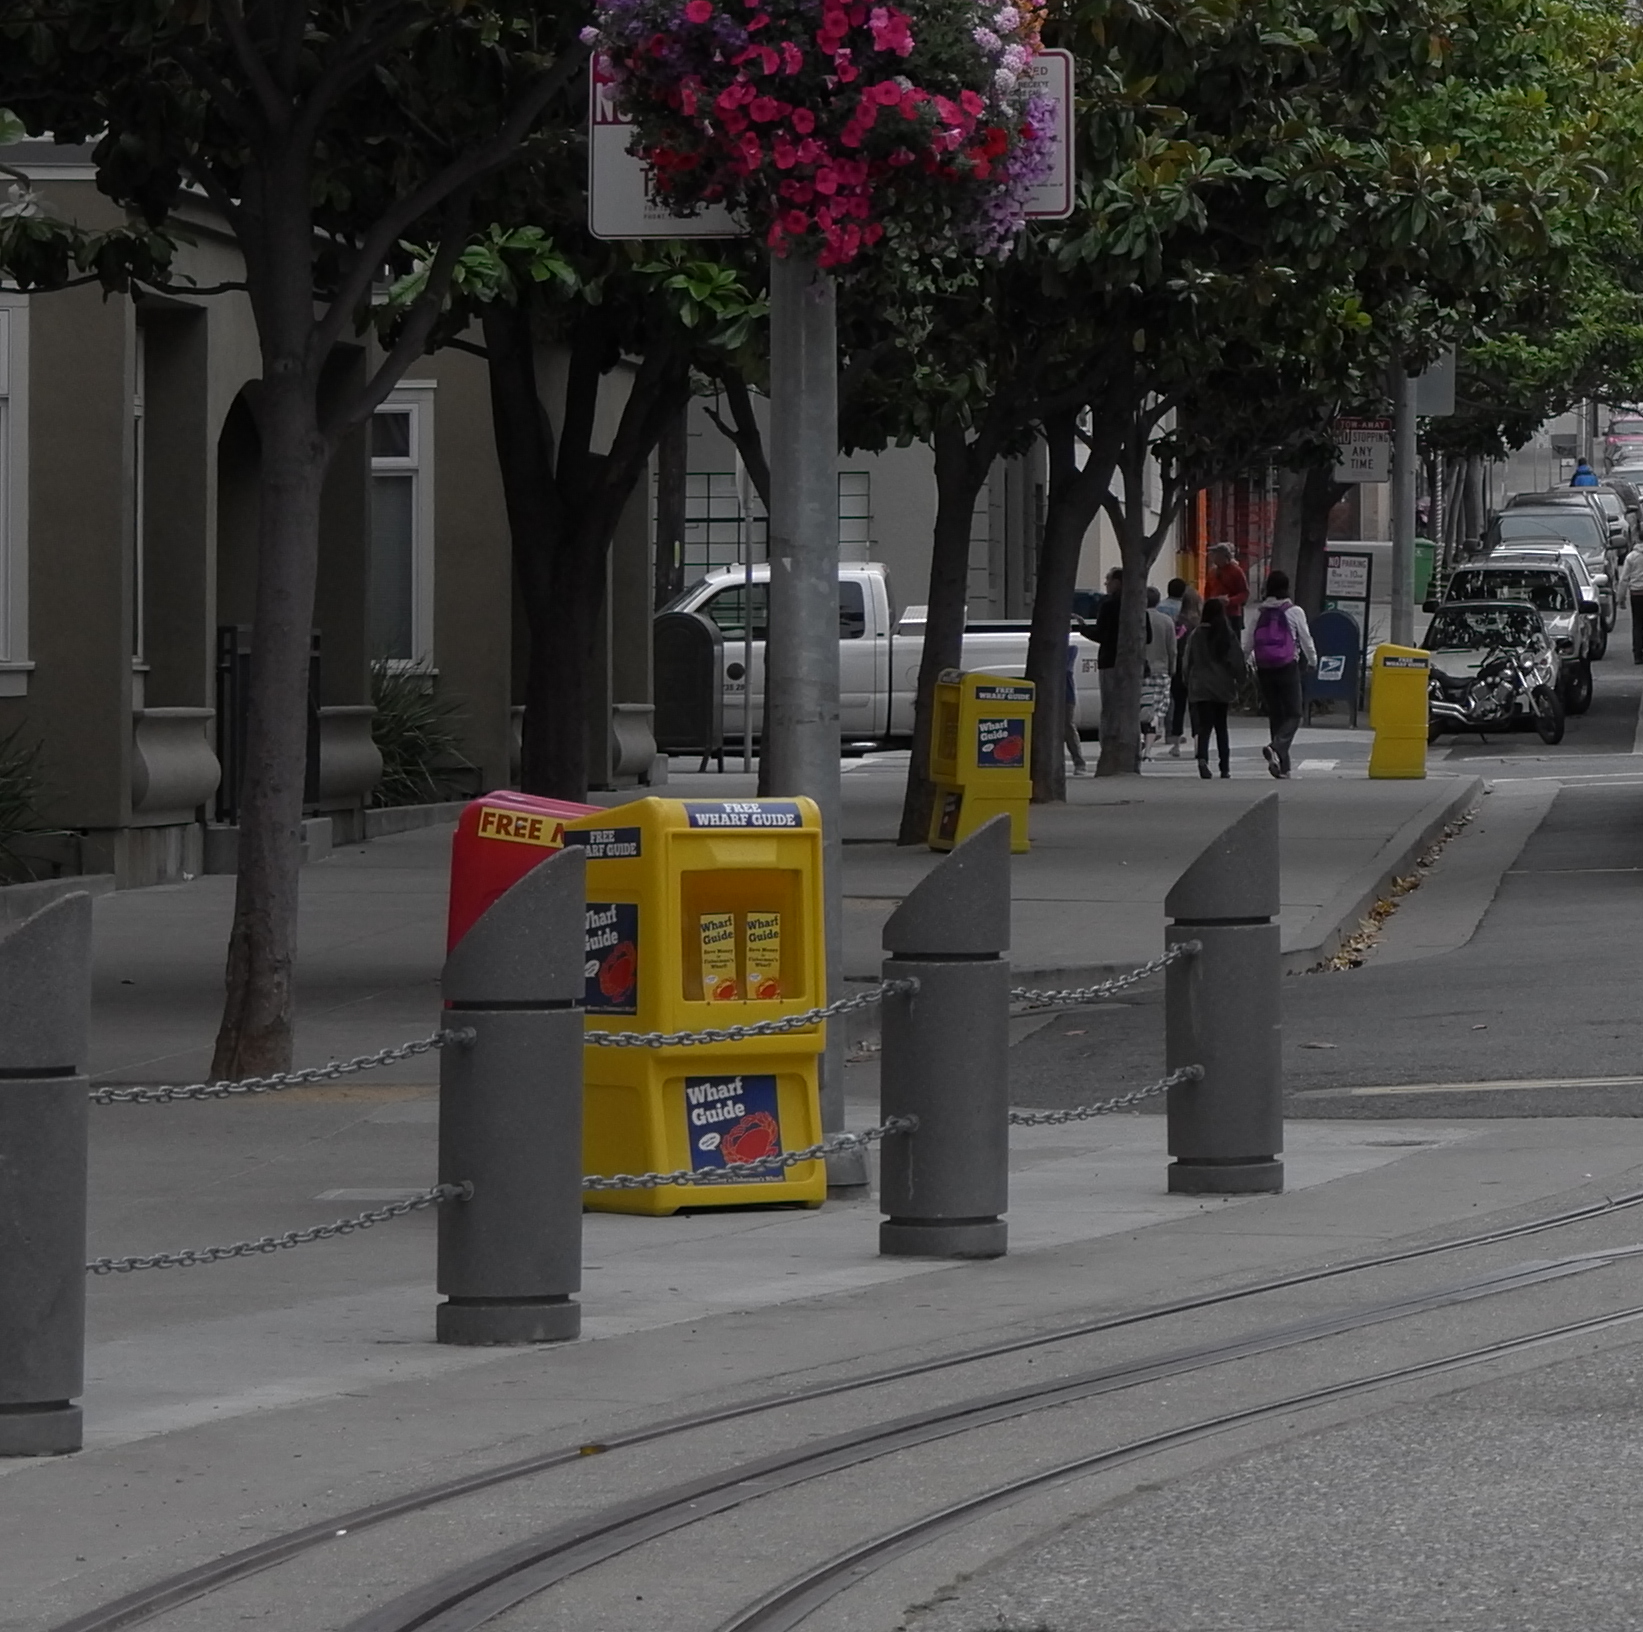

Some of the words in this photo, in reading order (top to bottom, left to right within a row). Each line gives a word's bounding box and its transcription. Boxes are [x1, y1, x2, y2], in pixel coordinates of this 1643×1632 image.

[1352, 432, 1389, 443] STOPPING
[1352, 446, 1373, 456] ANY
[1350, 459, 1374, 470] TIME
[978, 719, 1008, 732] Wharf
[980, 730, 1009, 741] Guide
[723, 803, 761, 813] FREE
[481, 811, 543, 841] FREE
[696, 812, 750, 826] WHARF
[752, 812, 796, 826] GUIDE
[590, 830, 615, 844] FREE
[585, 844, 605, 857] ARF
[606, 843, 637, 856] GUIDE
[701, 915, 732, 933] Wharf
[747, 915, 778, 931] Wharf
[703, 930, 734, 945] Guide
[748, 929, 779, 943] Guide
[687, 1076, 743, 1105] Wharf
[691, 1100, 746, 1126] Guide
